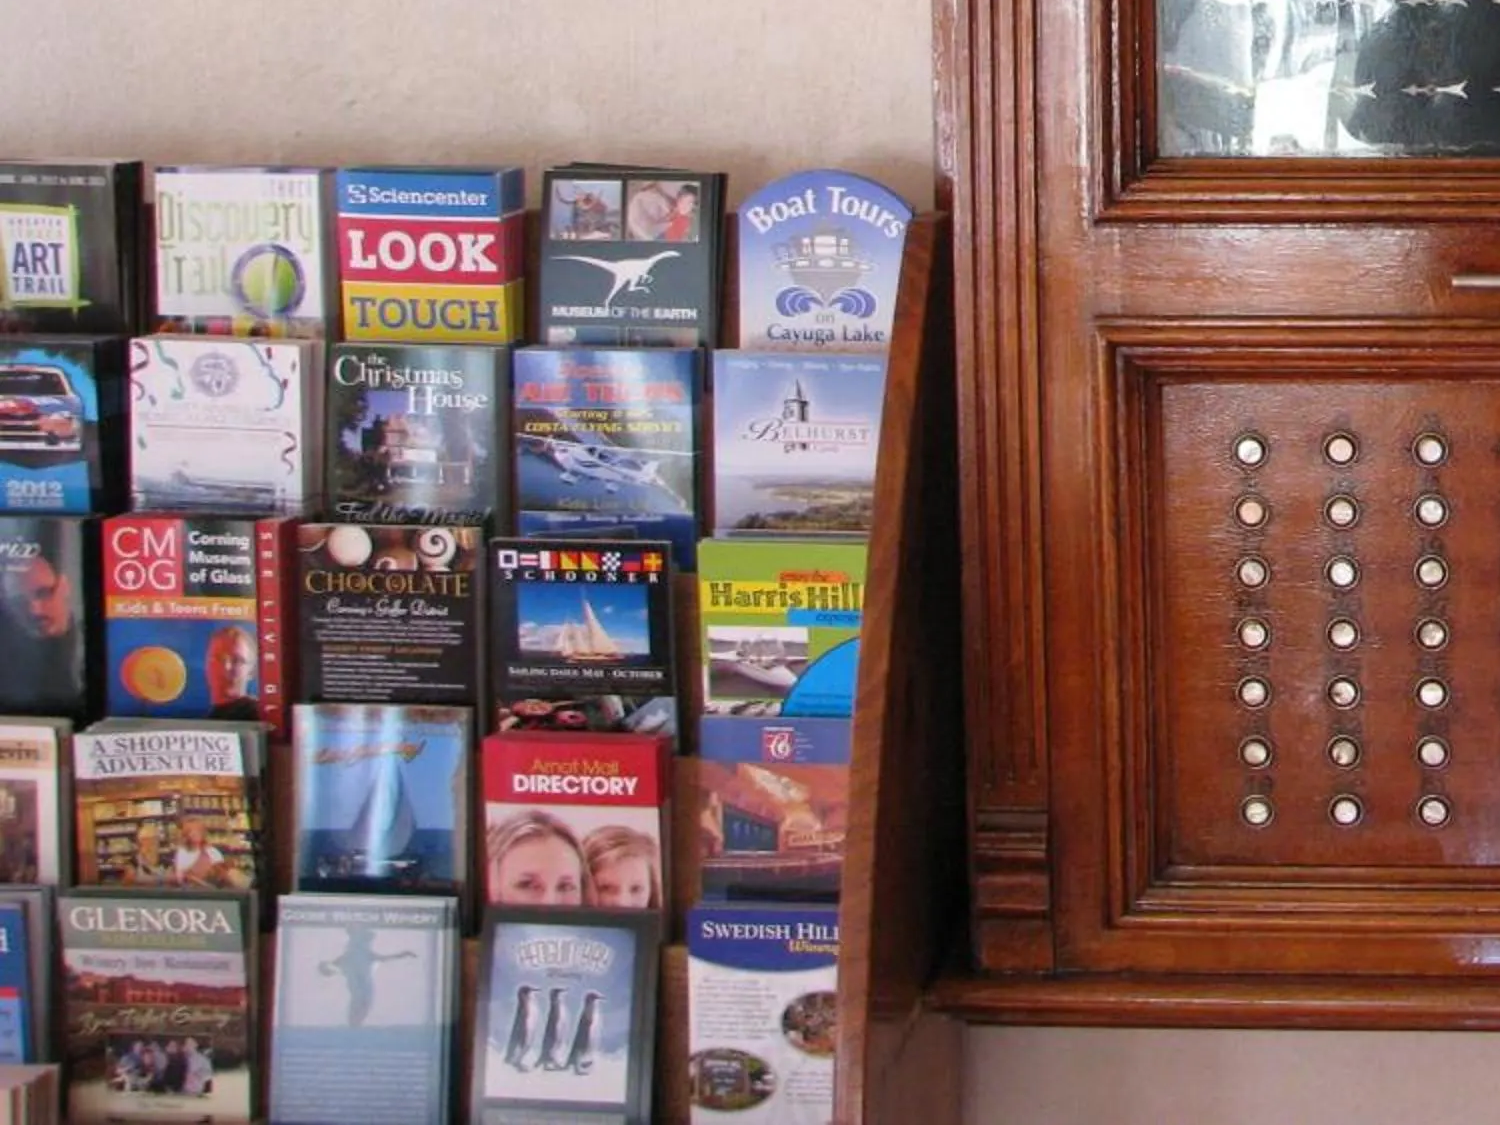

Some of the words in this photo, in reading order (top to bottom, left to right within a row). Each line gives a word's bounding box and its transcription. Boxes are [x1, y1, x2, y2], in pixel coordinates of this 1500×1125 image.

[368, 186, 489, 207] Sciencenter
[158, 190, 314, 254] Discovery
[746, 188, 817, 235] Boat
[825, 186, 904, 239] Tours
[12, 241, 64, 276] ART
[346, 229, 498, 273] LOOK
[158, 244, 234, 296] Trail
[12, 276, 66, 295] TRAIL
[351, 296, 500, 332] TOUCH
[551, 306, 609, 319] MUSEUM
[653, 307, 698, 321] EARTH
[766, 323, 836, 347] Cayuga
[842, 322, 885, 343] Lake
[334, 355, 464, 390] Christmas
[406, 385, 489, 416] House
[7, 479, 64, 498] 2012
[111, 526, 177, 558] CM
[187, 531, 250, 550] Corning
[188, 550, 251, 567] Museum
[113, 558, 177, 591] OG
[189, 568, 207, 584] of
[210, 568, 252, 585] Glass
[306, 570, 471, 598] CHOCOLATE
[503, 569, 660, 584] SCHOONER
[115, 601, 148, 616] Kids
[152, 601, 164, 614] &
[169, 602, 208, 616] Teens
[709, 582, 803, 608] Harris
[805, 582, 862, 612] Hill
[92, 738, 107, 755] A
[113, 735, 230, 754] SHOPPING
[94, 753, 233, 774] ADVENTURE
[512, 774, 639, 796] DIRECTORY
[69, 905, 234, 935] GLENORA
[702, 920, 791, 940] SWEDISH
